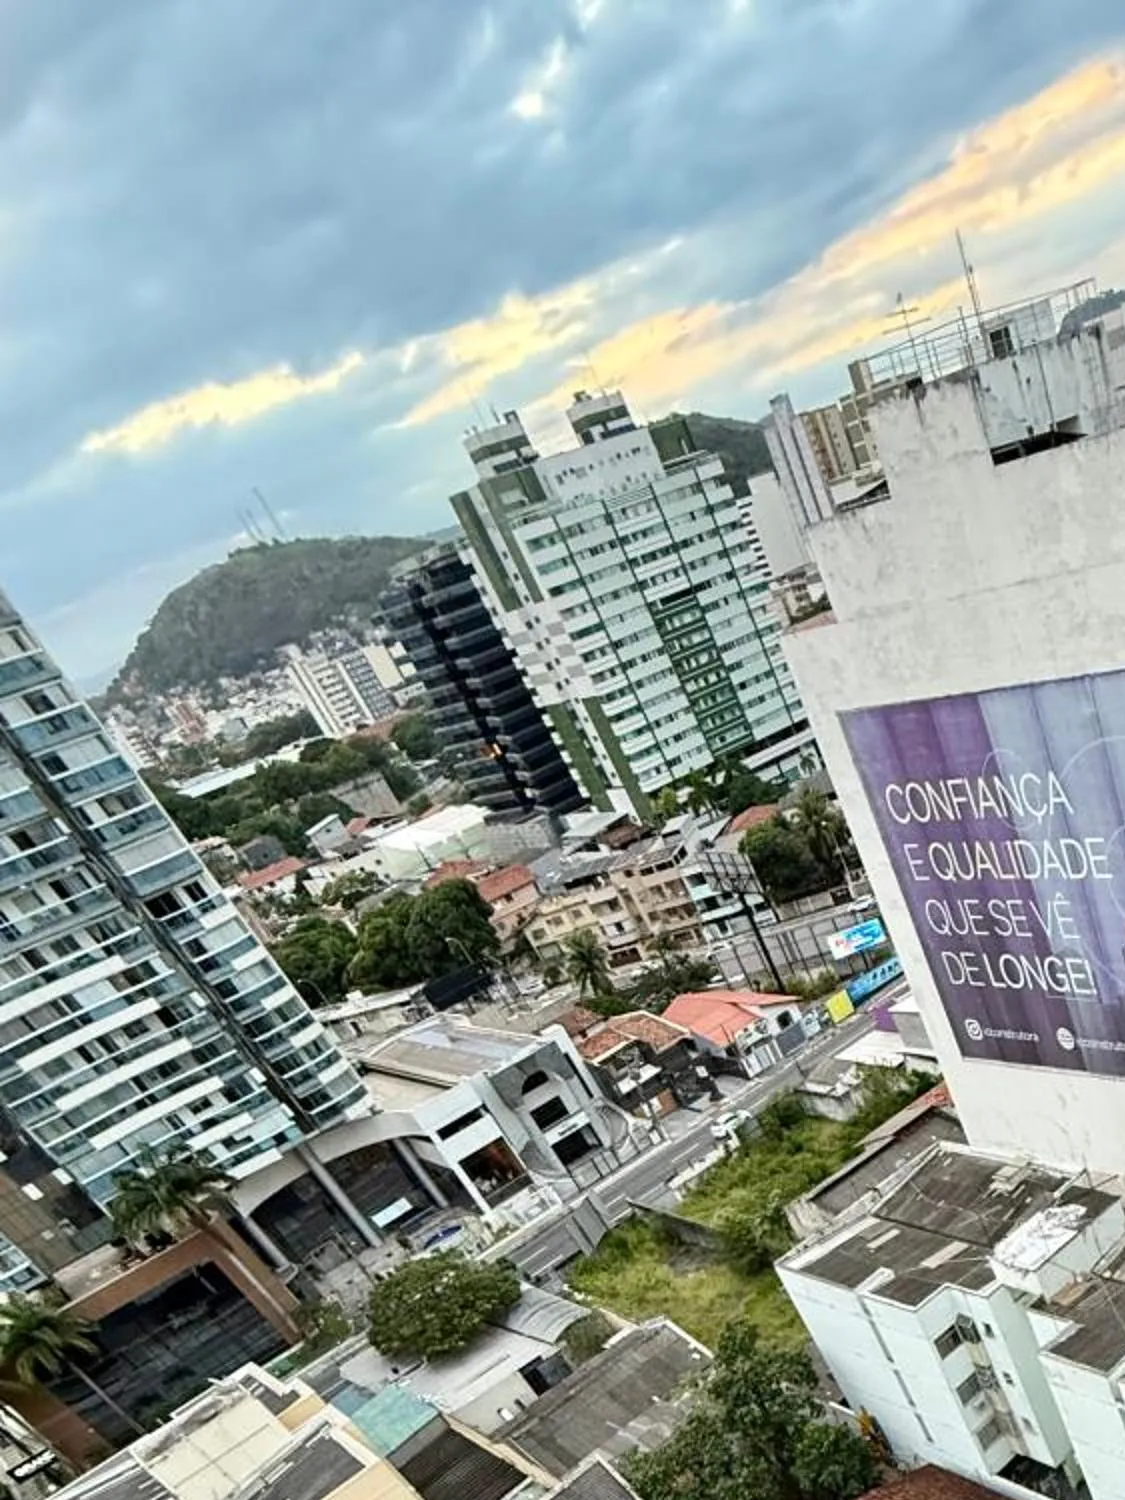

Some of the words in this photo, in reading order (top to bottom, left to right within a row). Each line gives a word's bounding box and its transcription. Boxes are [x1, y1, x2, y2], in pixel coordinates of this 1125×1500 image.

[885, 770, 1075, 825] CONFIANÇA
[903, 843, 931, 881] E
[927, 837, 1114, 884] QUALIDADE
[925, 899, 990, 937] QUE
[987, 898, 1033, 938] SE
[1029, 892, 1082, 940] VÊ
[941, 951, 986, 987] DE
[982, 952, 1098, 996] LONGE!
